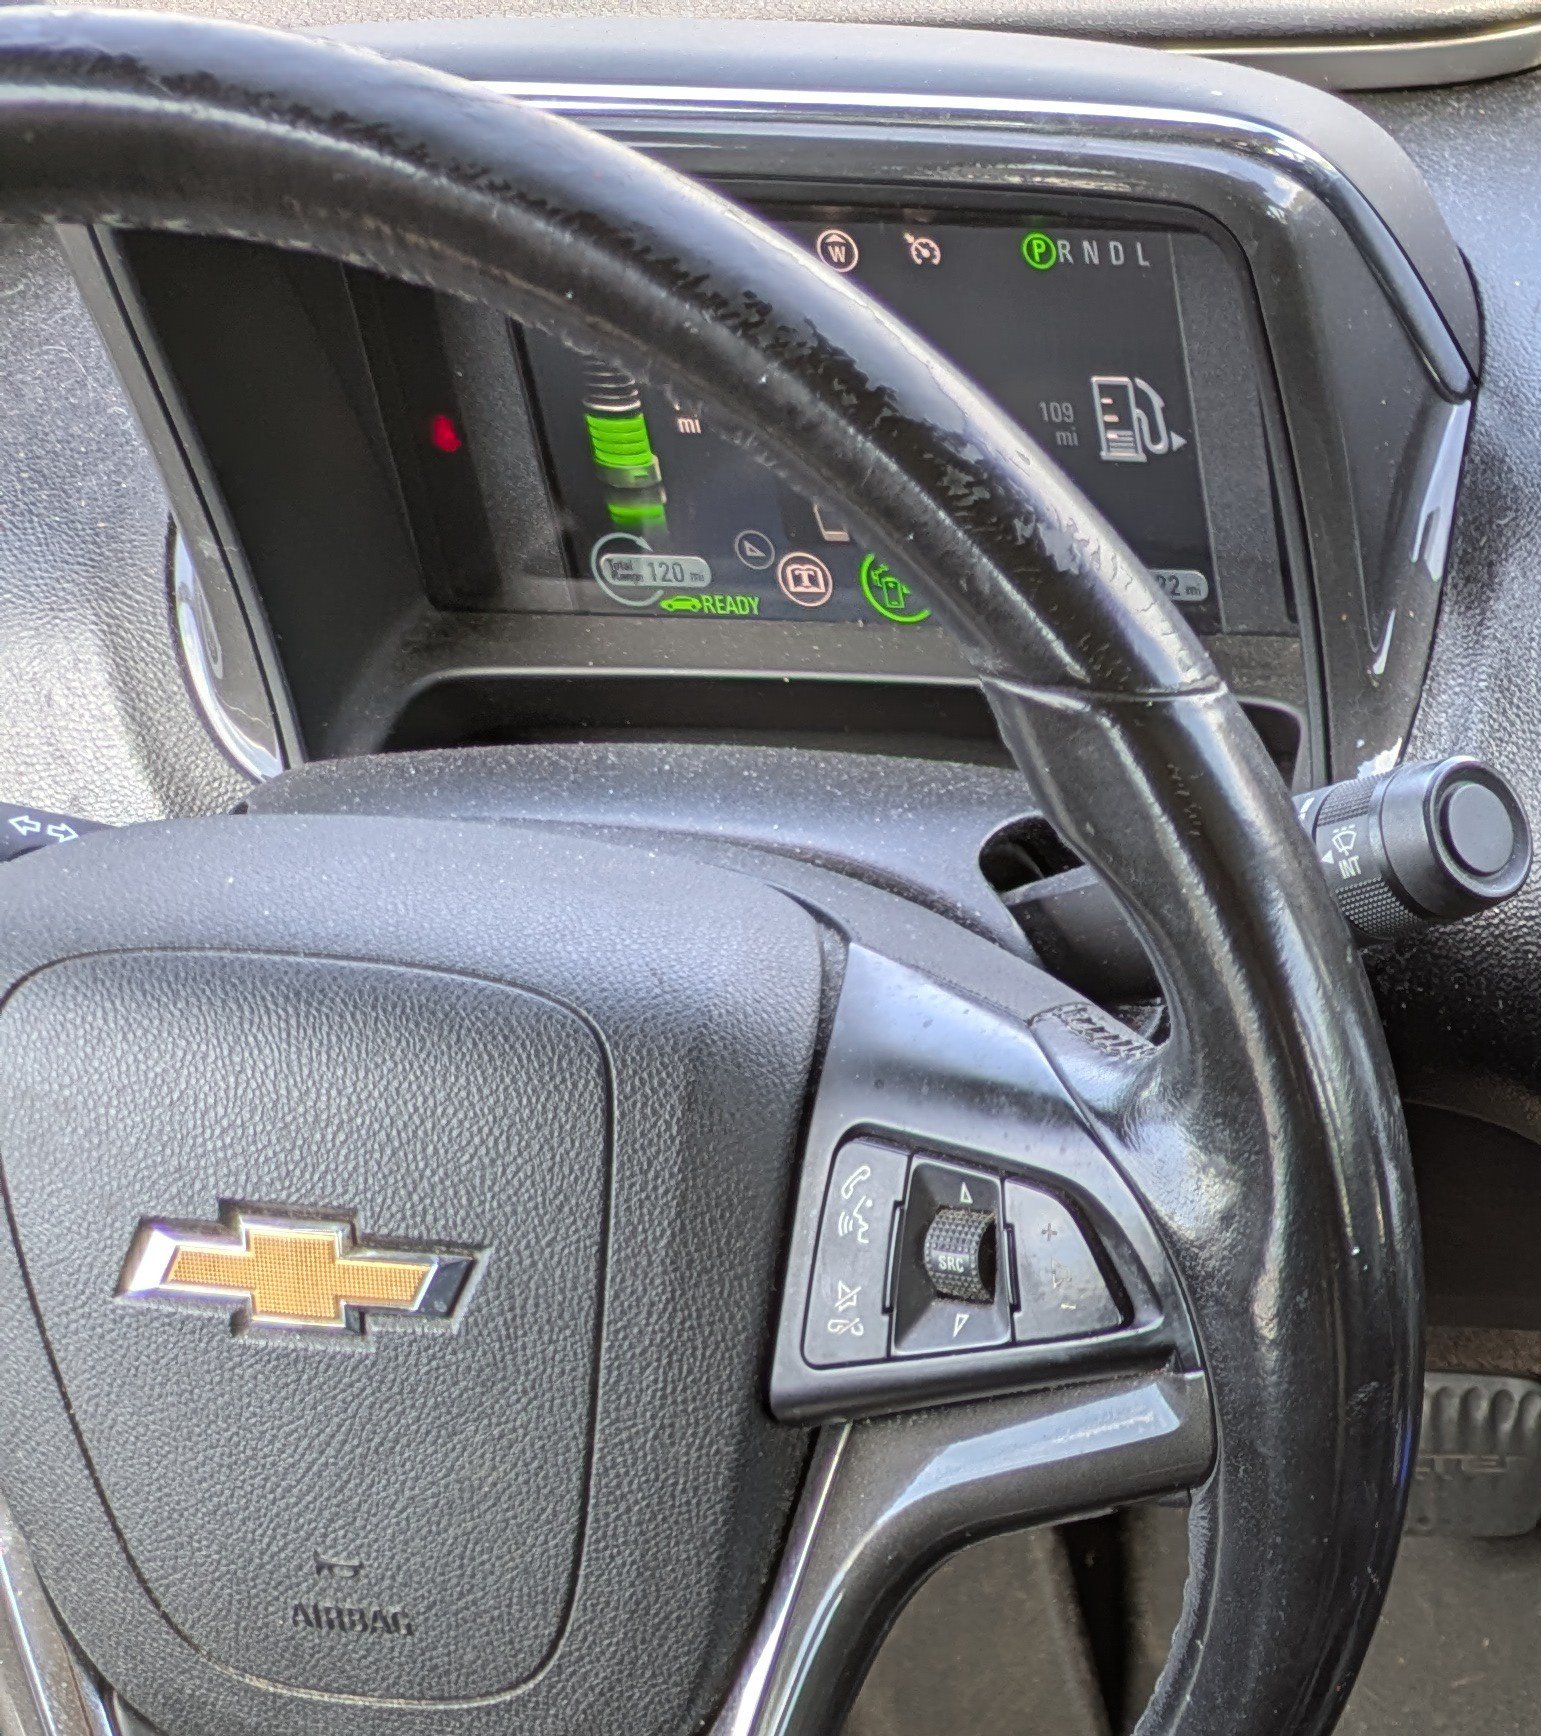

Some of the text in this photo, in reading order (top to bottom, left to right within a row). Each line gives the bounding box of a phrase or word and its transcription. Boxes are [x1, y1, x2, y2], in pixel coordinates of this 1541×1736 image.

[1058, 241, 1073, 263] R
[1083, 242, 1099, 265] N
[1109, 243, 1124, 265] D
[1137, 243, 1151, 267] L
[1039, 401, 1074, 423] 109
[1055, 431, 1079, 446] mi
[647, 562, 684, 583] 120
[702, 595, 760, 615] READY
[1338, 854, 1362, 880] INT
[938, 1254, 964, 1273] SRC
[292, 1602, 414, 1636] AIRBAG
